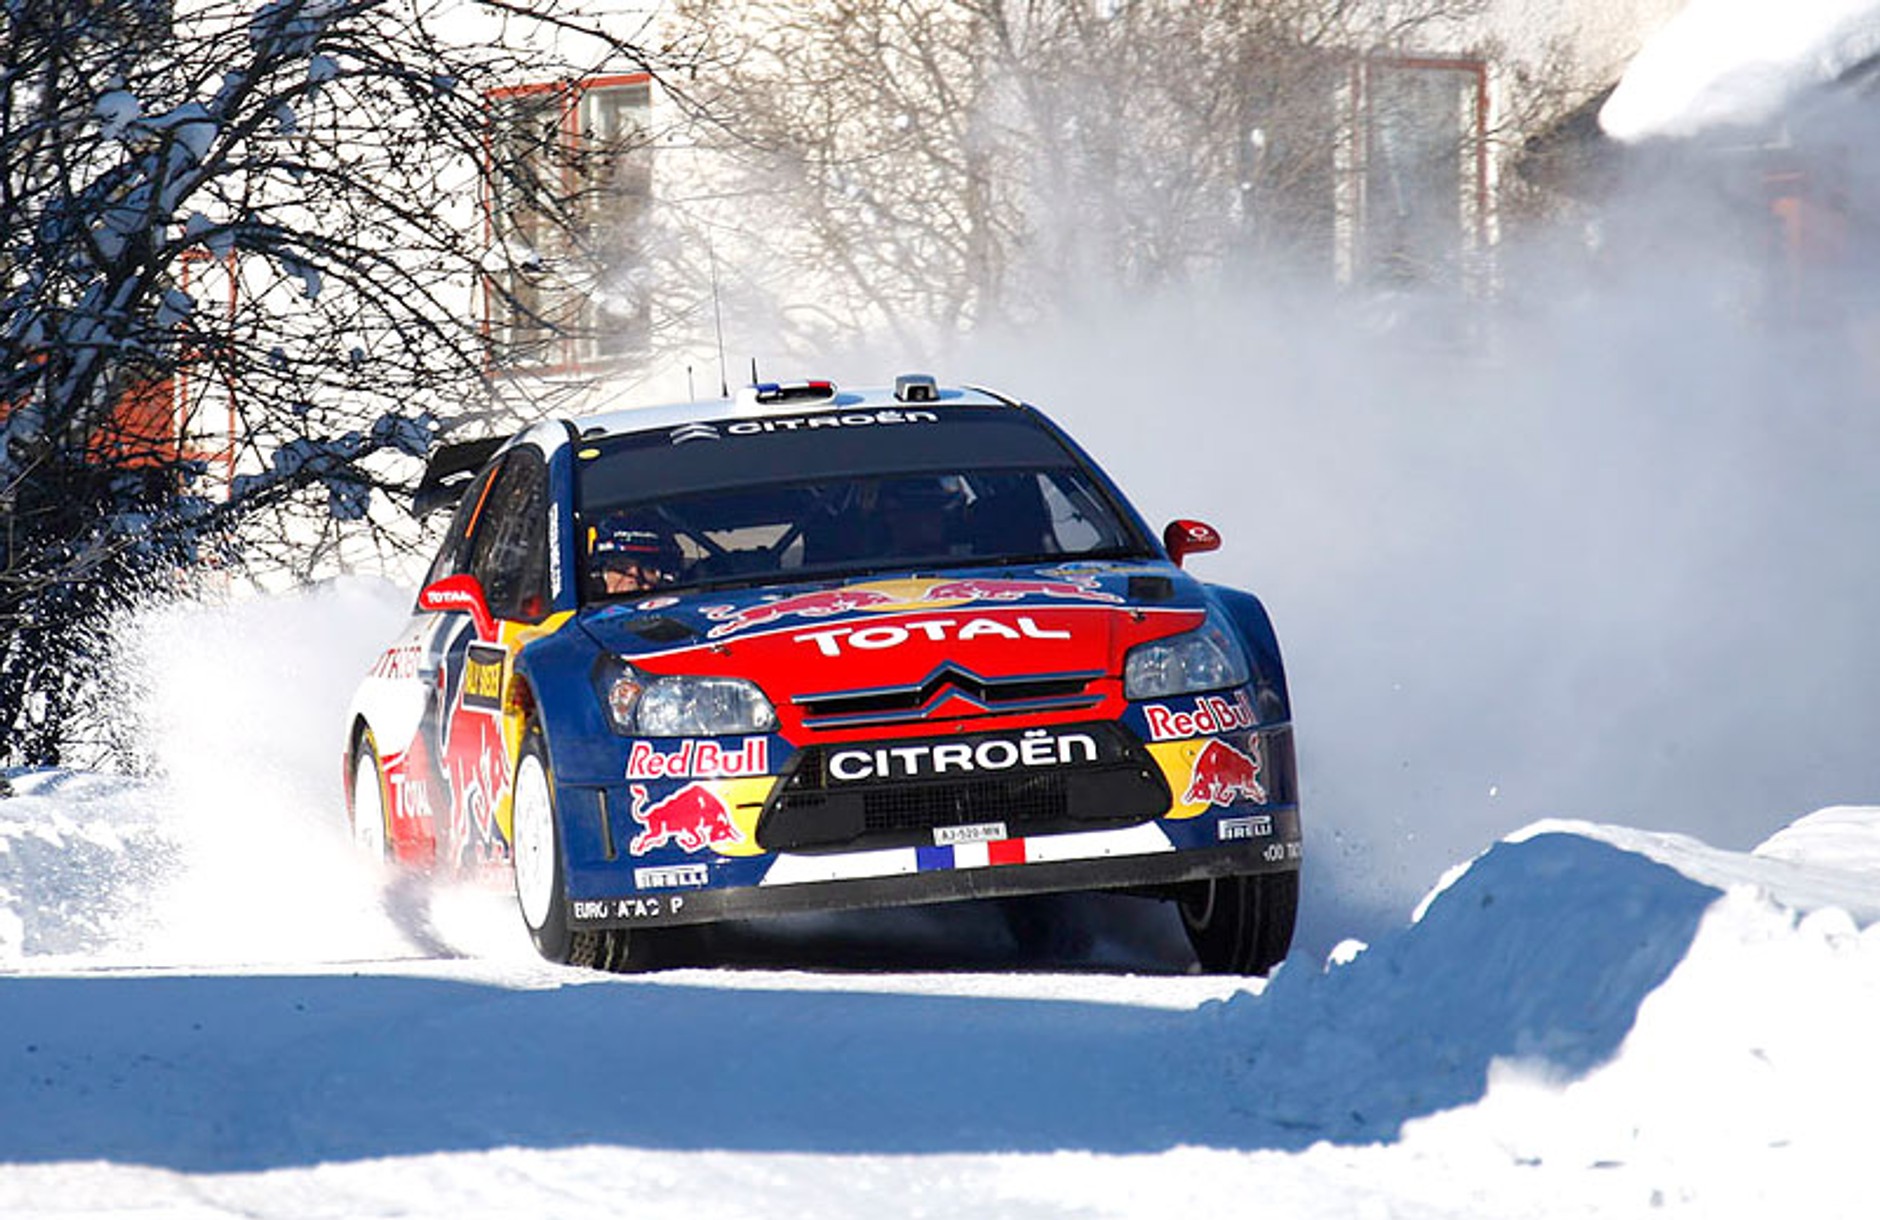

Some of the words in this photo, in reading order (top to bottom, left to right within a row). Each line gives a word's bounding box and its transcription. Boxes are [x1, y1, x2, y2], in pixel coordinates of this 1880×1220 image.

[794, 617, 1072, 657] TOTAL
[1143, 697, 1218, 741] Red
[626, 740, 694, 779] Red
[692, 736, 768, 777] Bull
[828, 729, 1098, 780] CITROËN
[1219, 816, 1272, 839] PIRELLI
